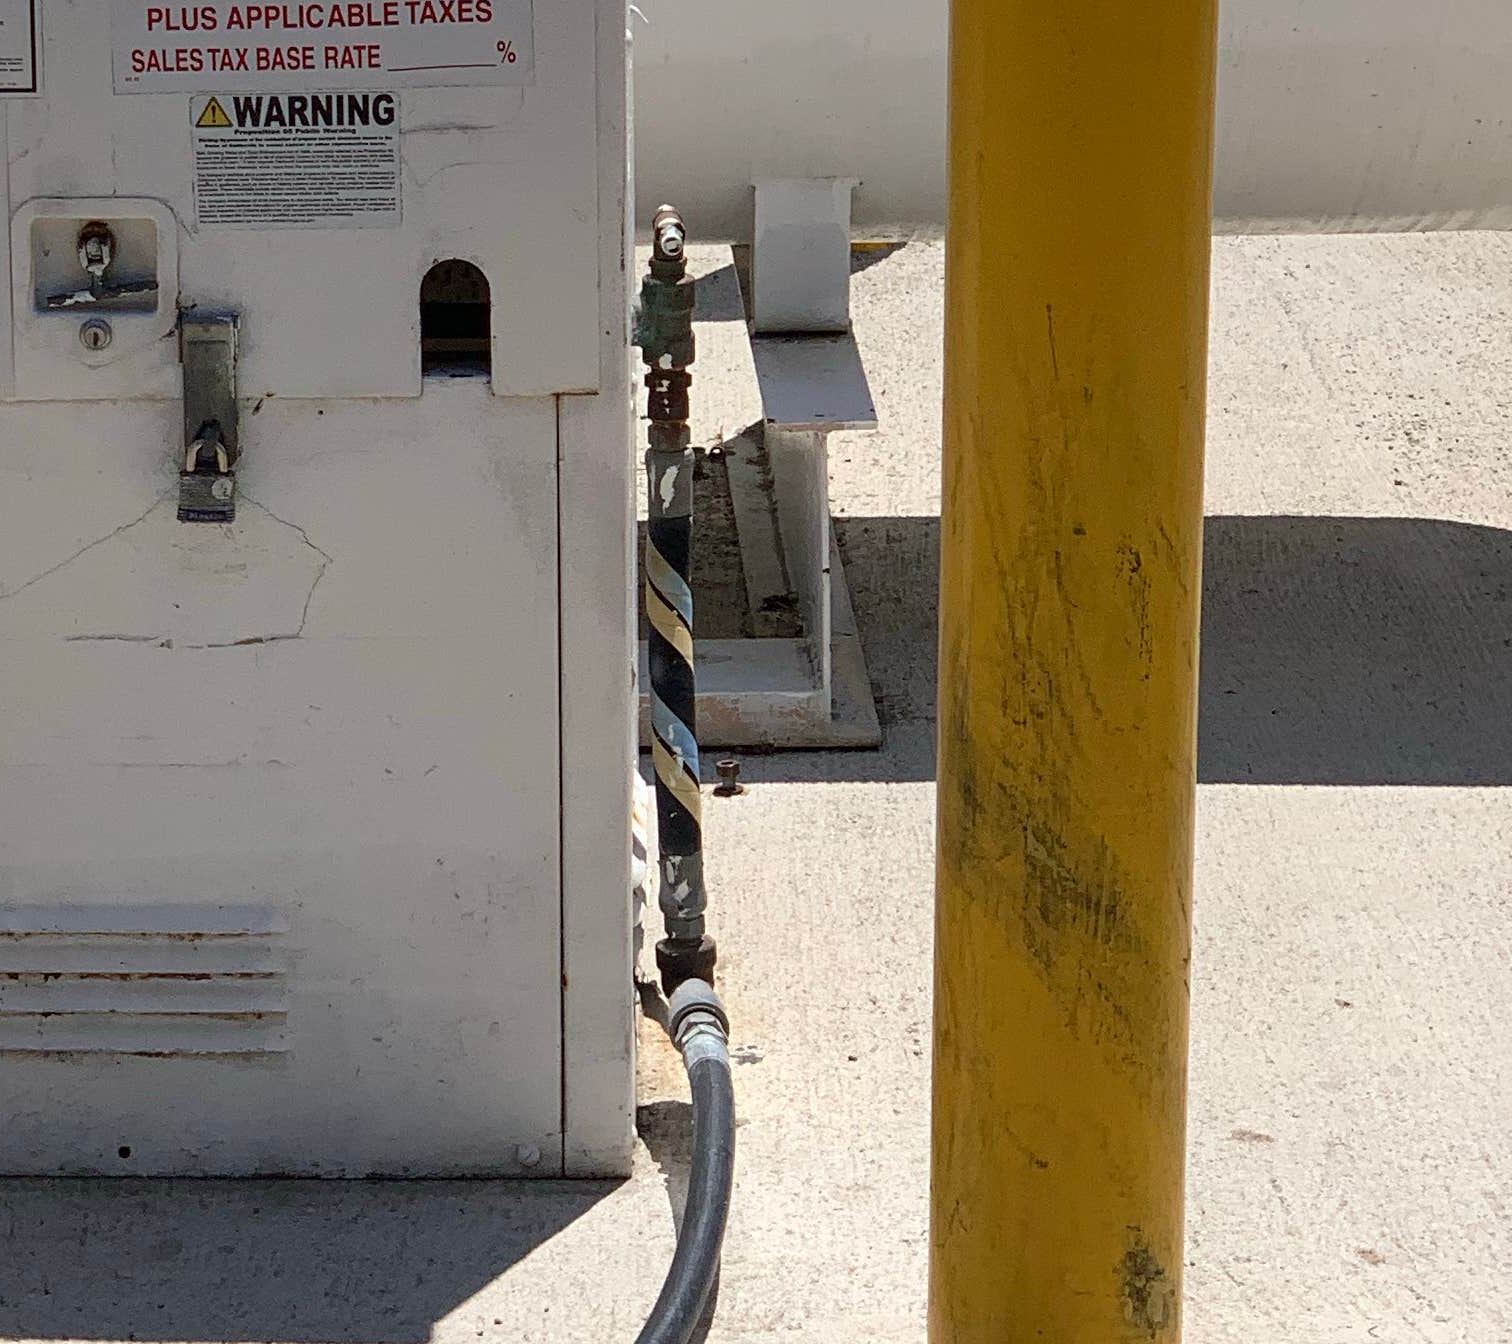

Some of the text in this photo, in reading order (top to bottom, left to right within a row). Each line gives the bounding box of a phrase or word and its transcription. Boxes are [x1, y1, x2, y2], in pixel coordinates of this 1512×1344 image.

[147, 6, 217, 31] PLUS
[226, 1, 399, 30] APPLICABLE
[131, 48, 203, 73] SALES
[206, 47, 249, 71] TAX
[256, 46, 315, 71] BASE
[324, 44, 381, 69] RATE
[232, 94, 395, 128] WARNING
